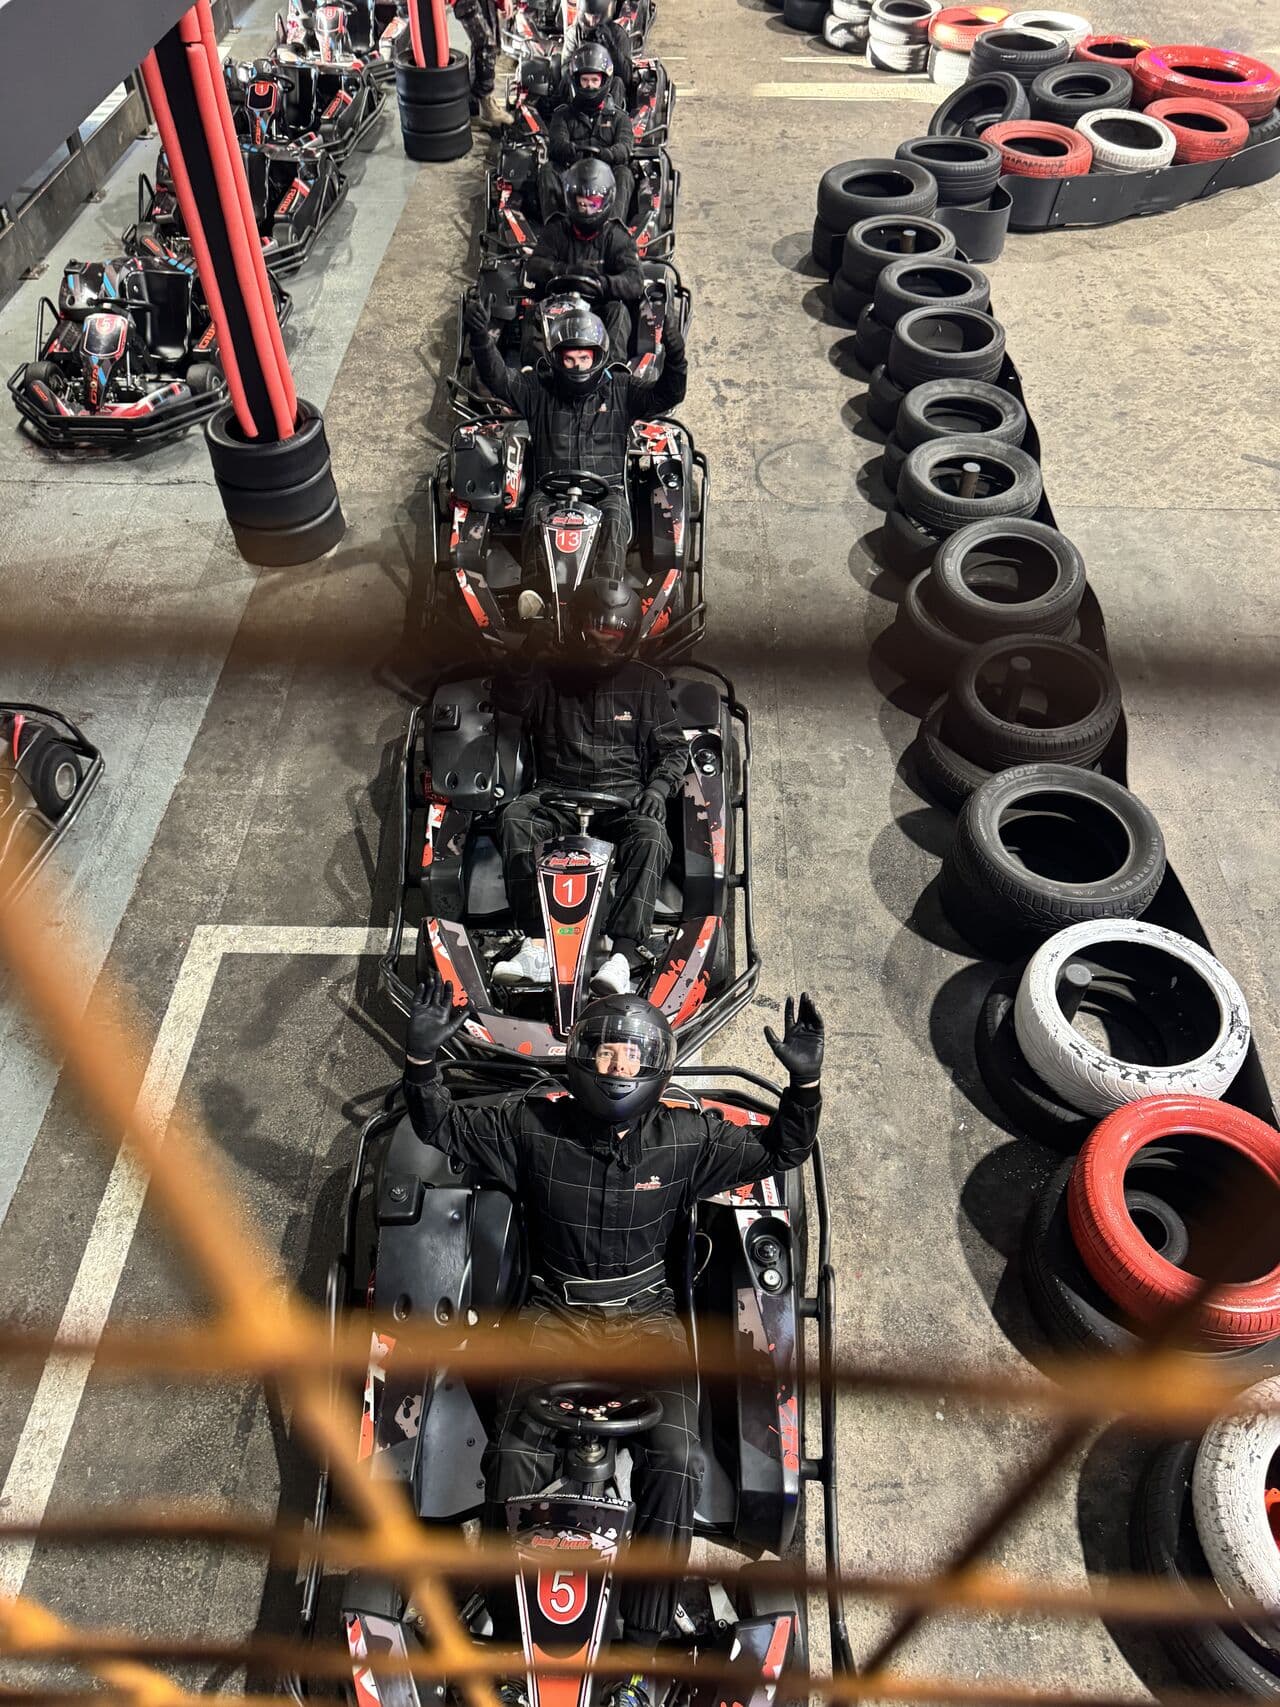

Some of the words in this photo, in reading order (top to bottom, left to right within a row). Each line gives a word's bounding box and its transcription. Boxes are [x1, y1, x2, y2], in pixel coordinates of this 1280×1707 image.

[558, 532, 579, 547] 13
[995, 765, 1038, 786] SNOW
[561, 878, 573, 903] 1
[607, 1498, 628, 1507] FAST
[550, 1570, 576, 1614] 5
